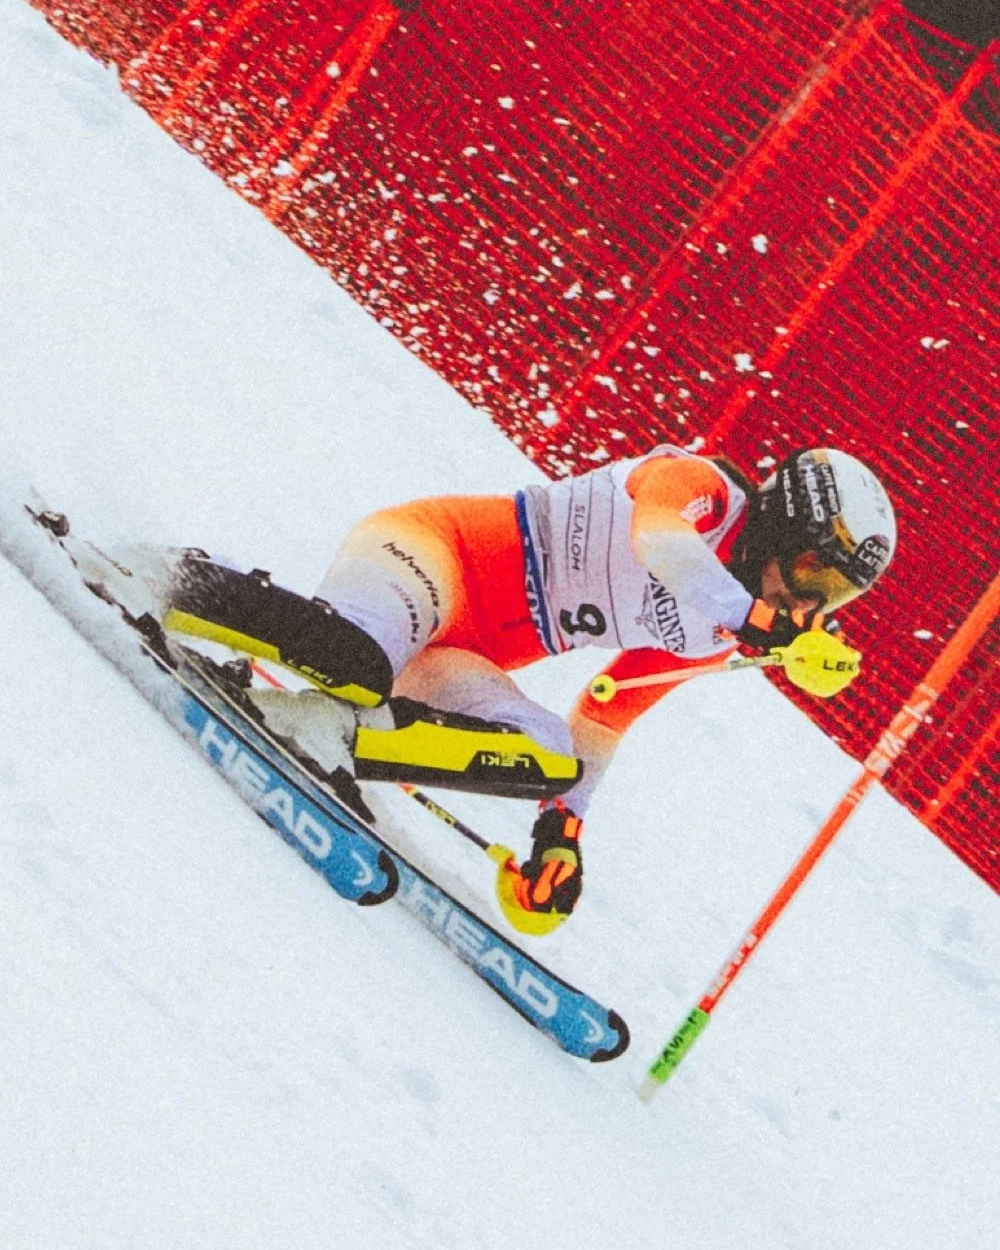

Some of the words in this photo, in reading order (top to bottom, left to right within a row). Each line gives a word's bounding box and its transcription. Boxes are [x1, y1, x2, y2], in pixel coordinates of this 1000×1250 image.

[783, 469, 795, 517] HEAD
[805, 464, 825, 521] HEAD
[572, 504, 586, 571] SLALOM
[382, 542, 440, 607] helvetia
[559, 603, 607, 637] 9
[648, 572, 686, 654] NGINES
[822, 658, 857, 672] LEK
[200, 720, 333, 860] HEAD
[481, 751, 530, 768] LEKI
[406, 880, 558, 1018] HEAD
